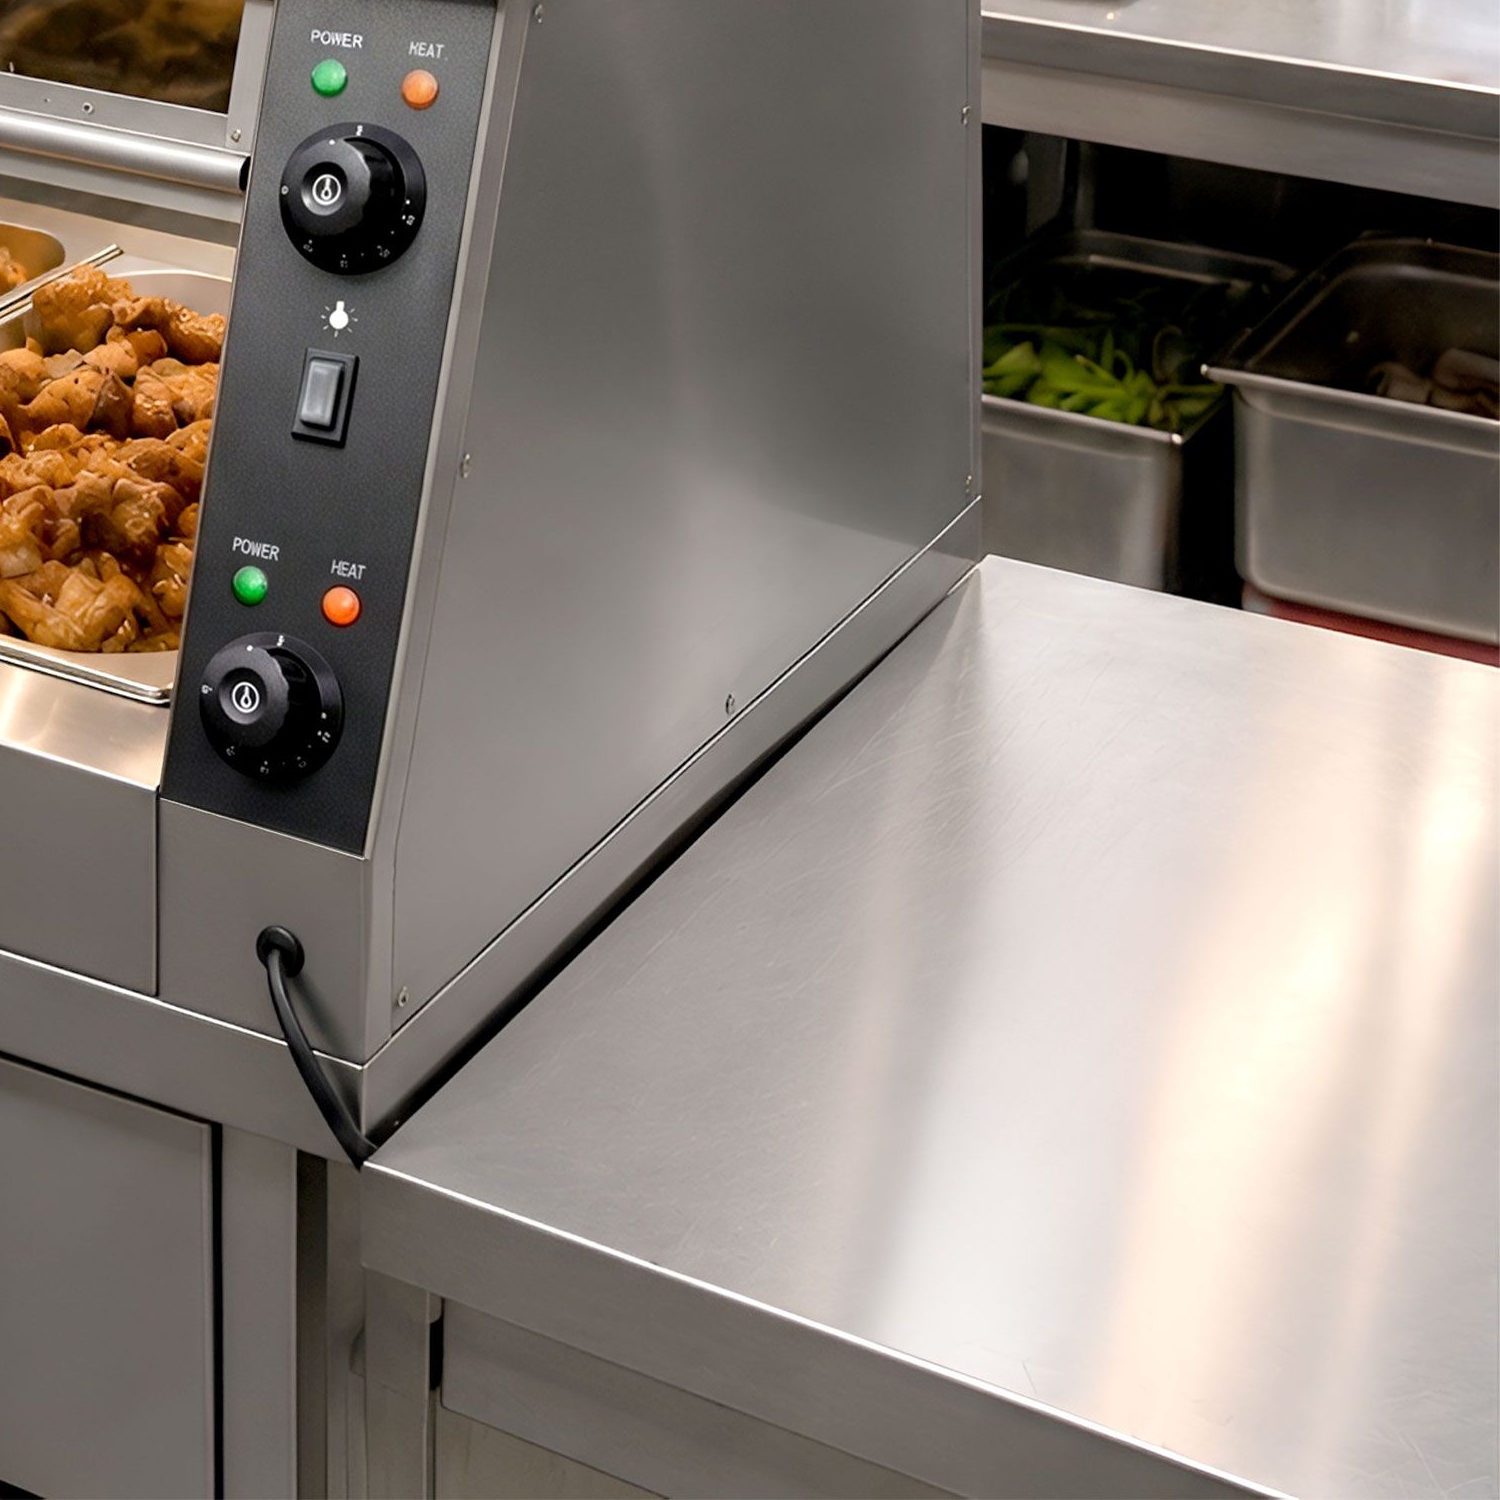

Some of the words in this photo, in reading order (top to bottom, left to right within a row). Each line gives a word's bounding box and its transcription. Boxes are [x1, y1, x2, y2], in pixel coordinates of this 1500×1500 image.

[310, 29, 364, 49] POWER
[232, 536, 280, 562] POWER
[330, 559, 367, 581] HEAT
